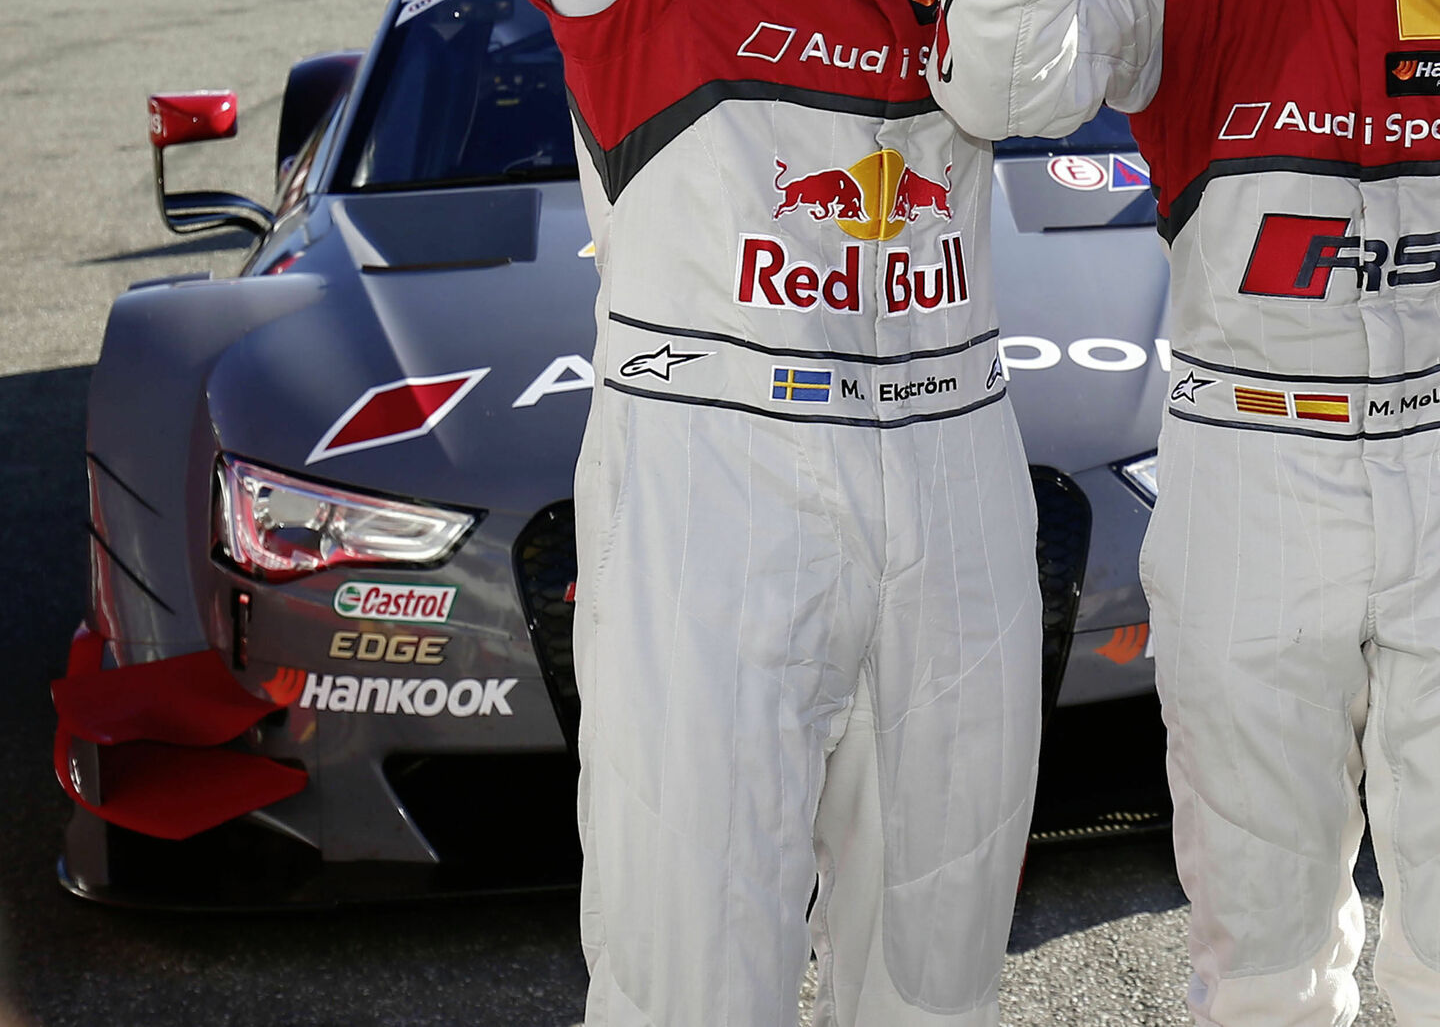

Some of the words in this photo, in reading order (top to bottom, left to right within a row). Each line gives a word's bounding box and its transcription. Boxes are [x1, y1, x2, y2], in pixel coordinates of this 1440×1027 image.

[799, 32, 910, 80] Audi
[1274, 101, 1373, 145] Audi
[739, 238, 860, 313] Red
[885, 236, 968, 314] Bull
[841, 378, 865, 400] M.
[880, 376, 957, 401] Ekström
[1368, 400, 1394, 416] M.
[361, 587, 450, 618] Castrol
[329, 631, 450, 664] EDGE
